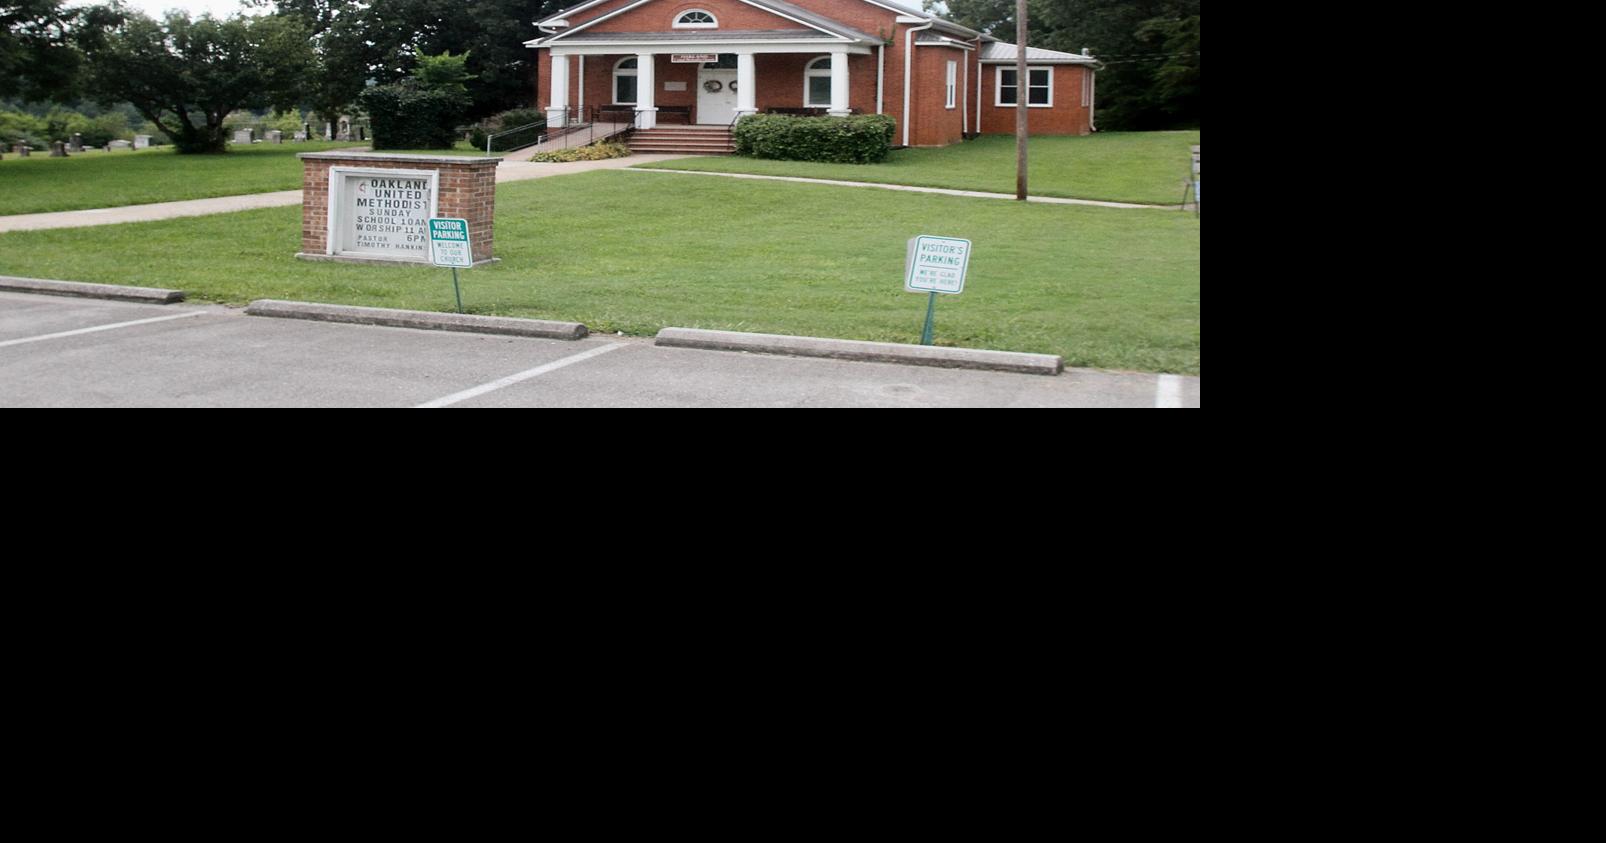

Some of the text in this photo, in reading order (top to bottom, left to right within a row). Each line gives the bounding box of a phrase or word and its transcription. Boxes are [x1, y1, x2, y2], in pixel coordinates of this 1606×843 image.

[375, 190, 422, 199] UNITED
[369, 209, 411, 217] SUNDAY
[357, 215, 396, 225] SCHOOL
[356, 223, 402, 233] WORSHIP
[405, 226, 414, 234] 11
[433, 221, 462, 230] VISITOR
[433, 230, 465, 239] PARKING
[437, 241, 464, 249] WELCOME
[921, 243, 965, 254] VISITOR'S
[919, 254, 960, 266] PARKING
